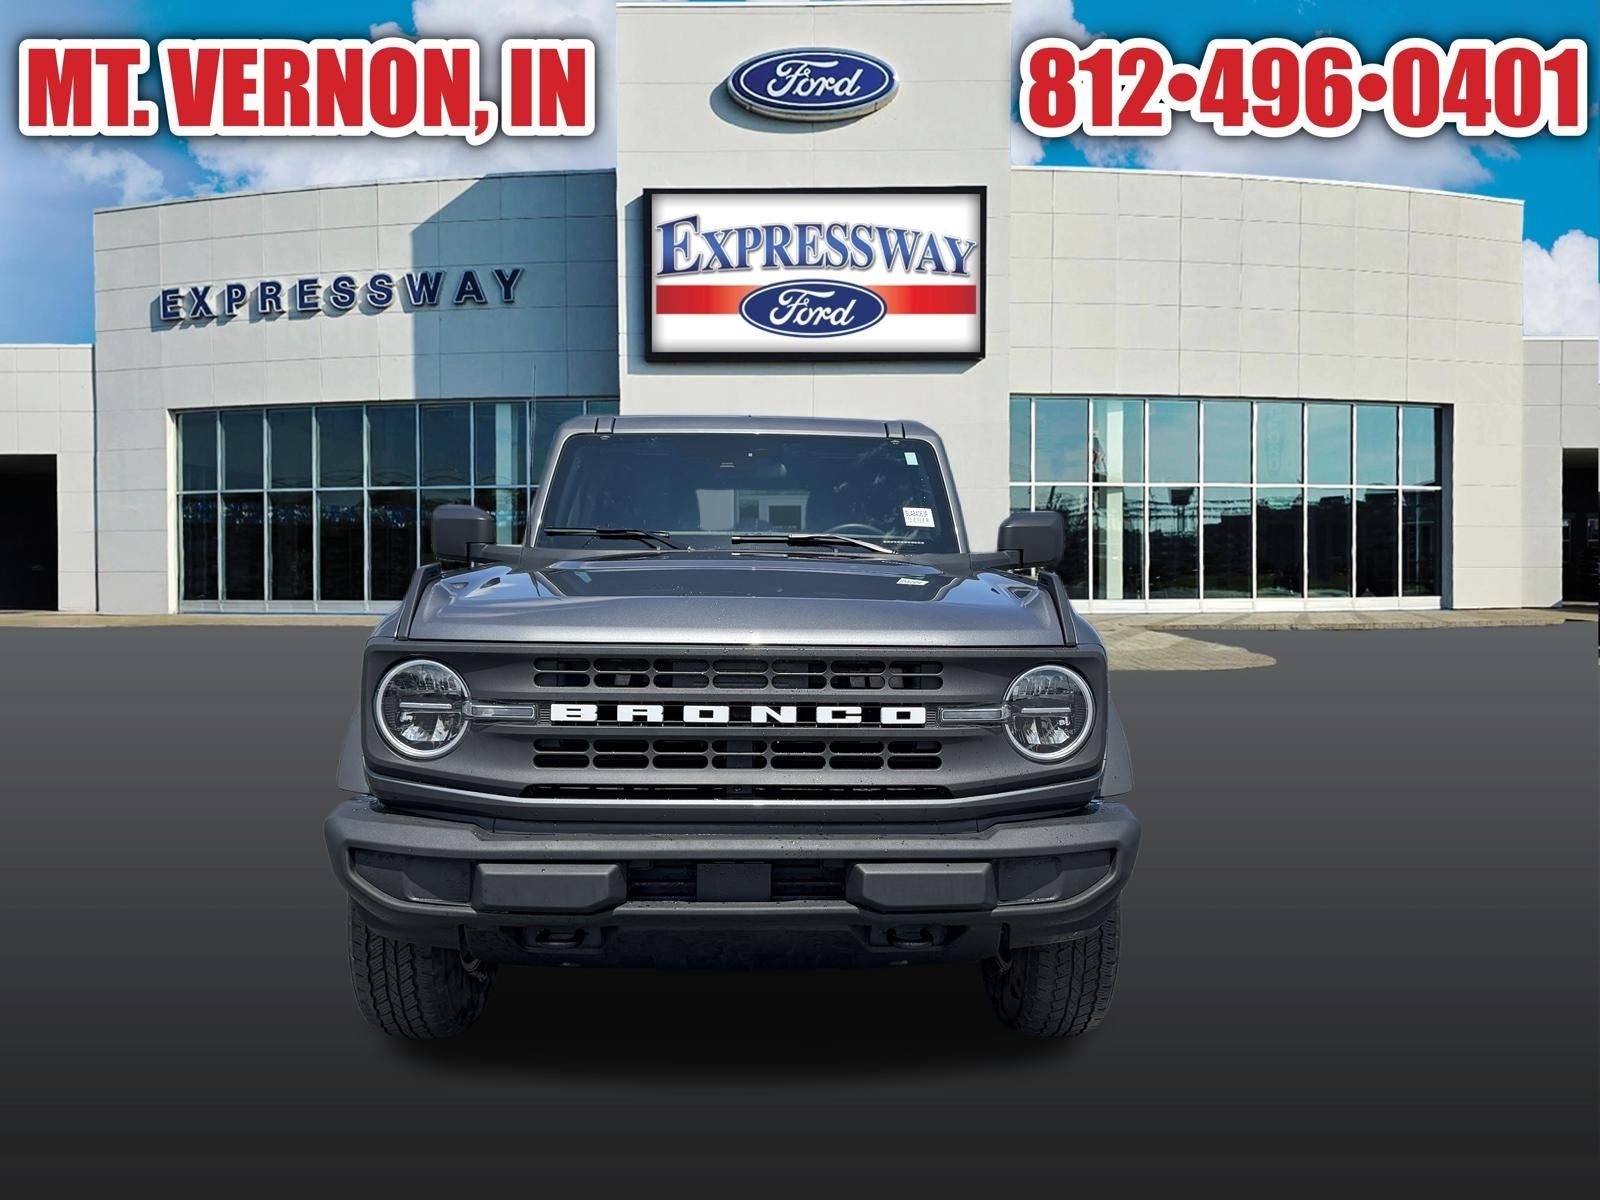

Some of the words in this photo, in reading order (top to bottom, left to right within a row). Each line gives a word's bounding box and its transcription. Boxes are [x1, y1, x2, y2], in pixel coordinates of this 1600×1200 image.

[766, 59, 863, 98] Ford
[655, 213, 979, 278] EXPRESSWAY
[159, 267, 526, 322] EXPRESSWAY
[769, 288, 857, 327] Ford
[549, 702, 927, 725] BRONCO
